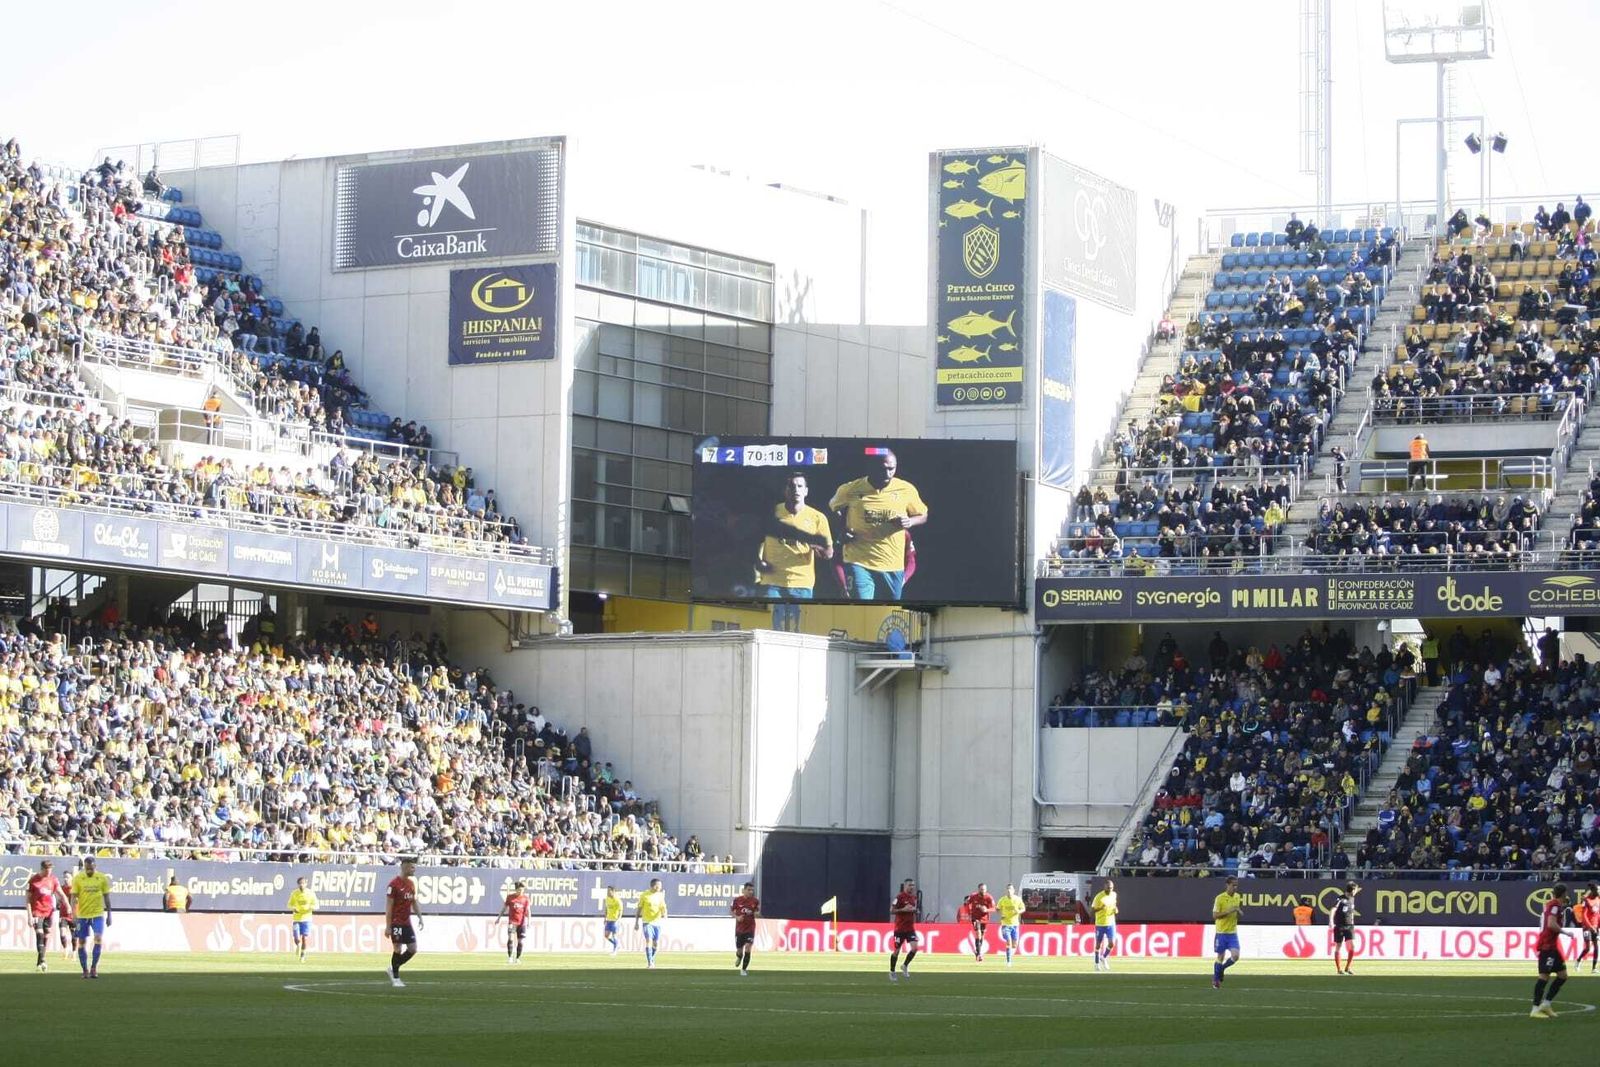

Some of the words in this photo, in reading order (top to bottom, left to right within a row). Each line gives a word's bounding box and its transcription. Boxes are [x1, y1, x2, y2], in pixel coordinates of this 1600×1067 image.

[397, 232, 487, 258] CaixaBank
[947, 284, 983, 293] PETACA
[985, 283, 1015, 292] CHICO
[468, 317, 537, 334] HISPANIA
[463, 338, 490, 346] servicios
[947, 371, 1013, 381] petacachico.com
[725, 449, 735, 461] 2
[747, 450, 784, 461] 70:18
[794, 450, 804, 462] 0
[1338, 578, 1414, 589] CONFEDERACIÓN
[1061, 589, 1123, 601] SERRANO
[1253, 588, 1319, 607] MILAR
[1338, 590, 1414, 599] EMPRESAS
[1338, 601, 1377, 610] PROVINCIA
[188, 877, 230, 898] Grupo
[231, 877, 274, 896] Solera
[311, 870, 377, 897] ENERYETI
[1376, 890, 1498, 914] macron
[393, 927, 402, 935] 24
[1394, 930, 1428, 959] TI,
[1440, 930, 1494, 958] LOS
